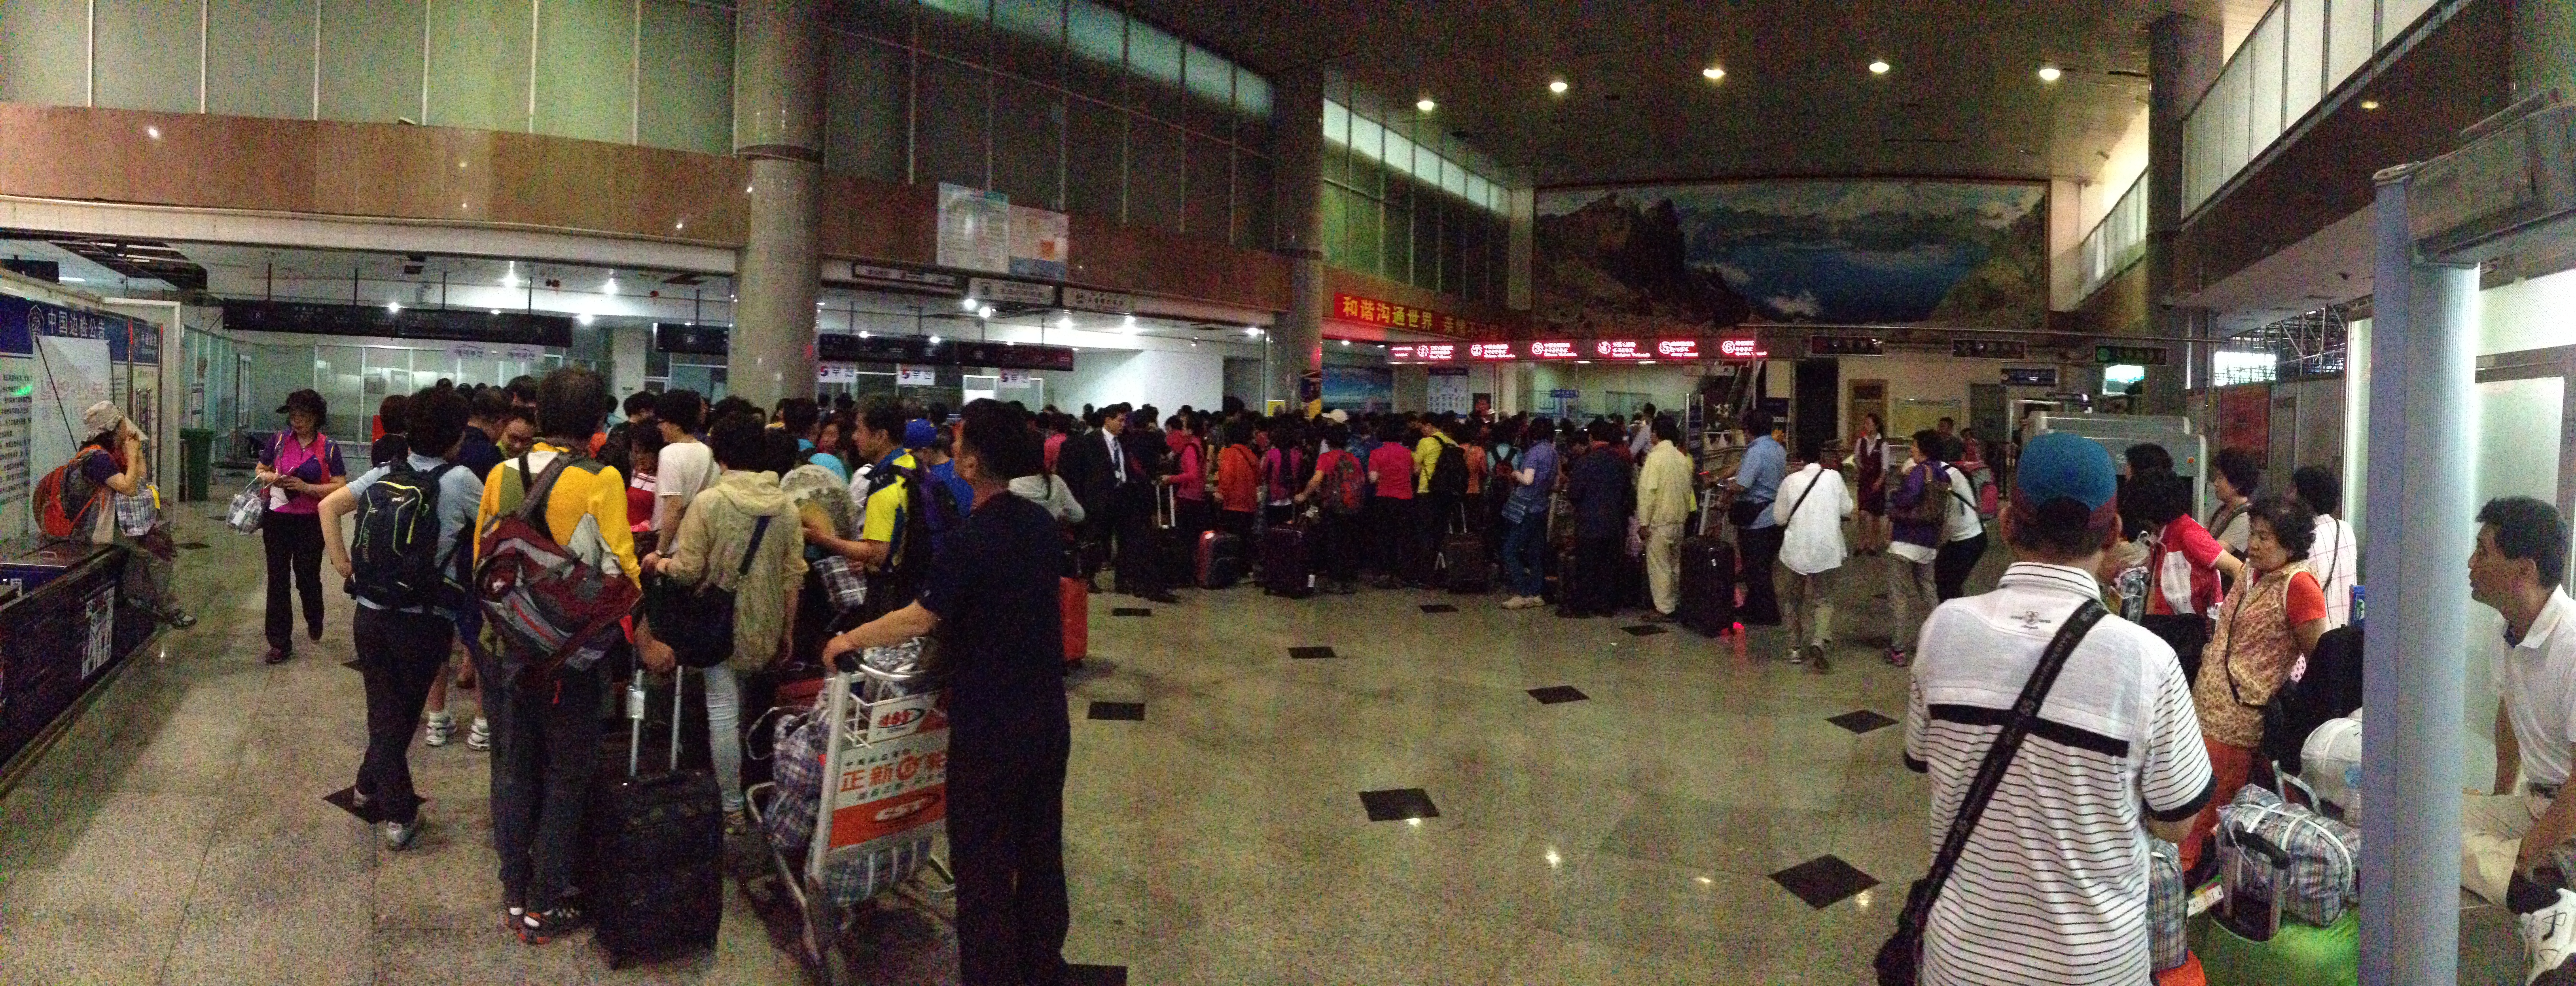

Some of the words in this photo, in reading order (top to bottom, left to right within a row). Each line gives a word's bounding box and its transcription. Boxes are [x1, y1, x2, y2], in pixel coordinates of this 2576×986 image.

[1343, 296, 1432, 330] 和谐沟通世界
